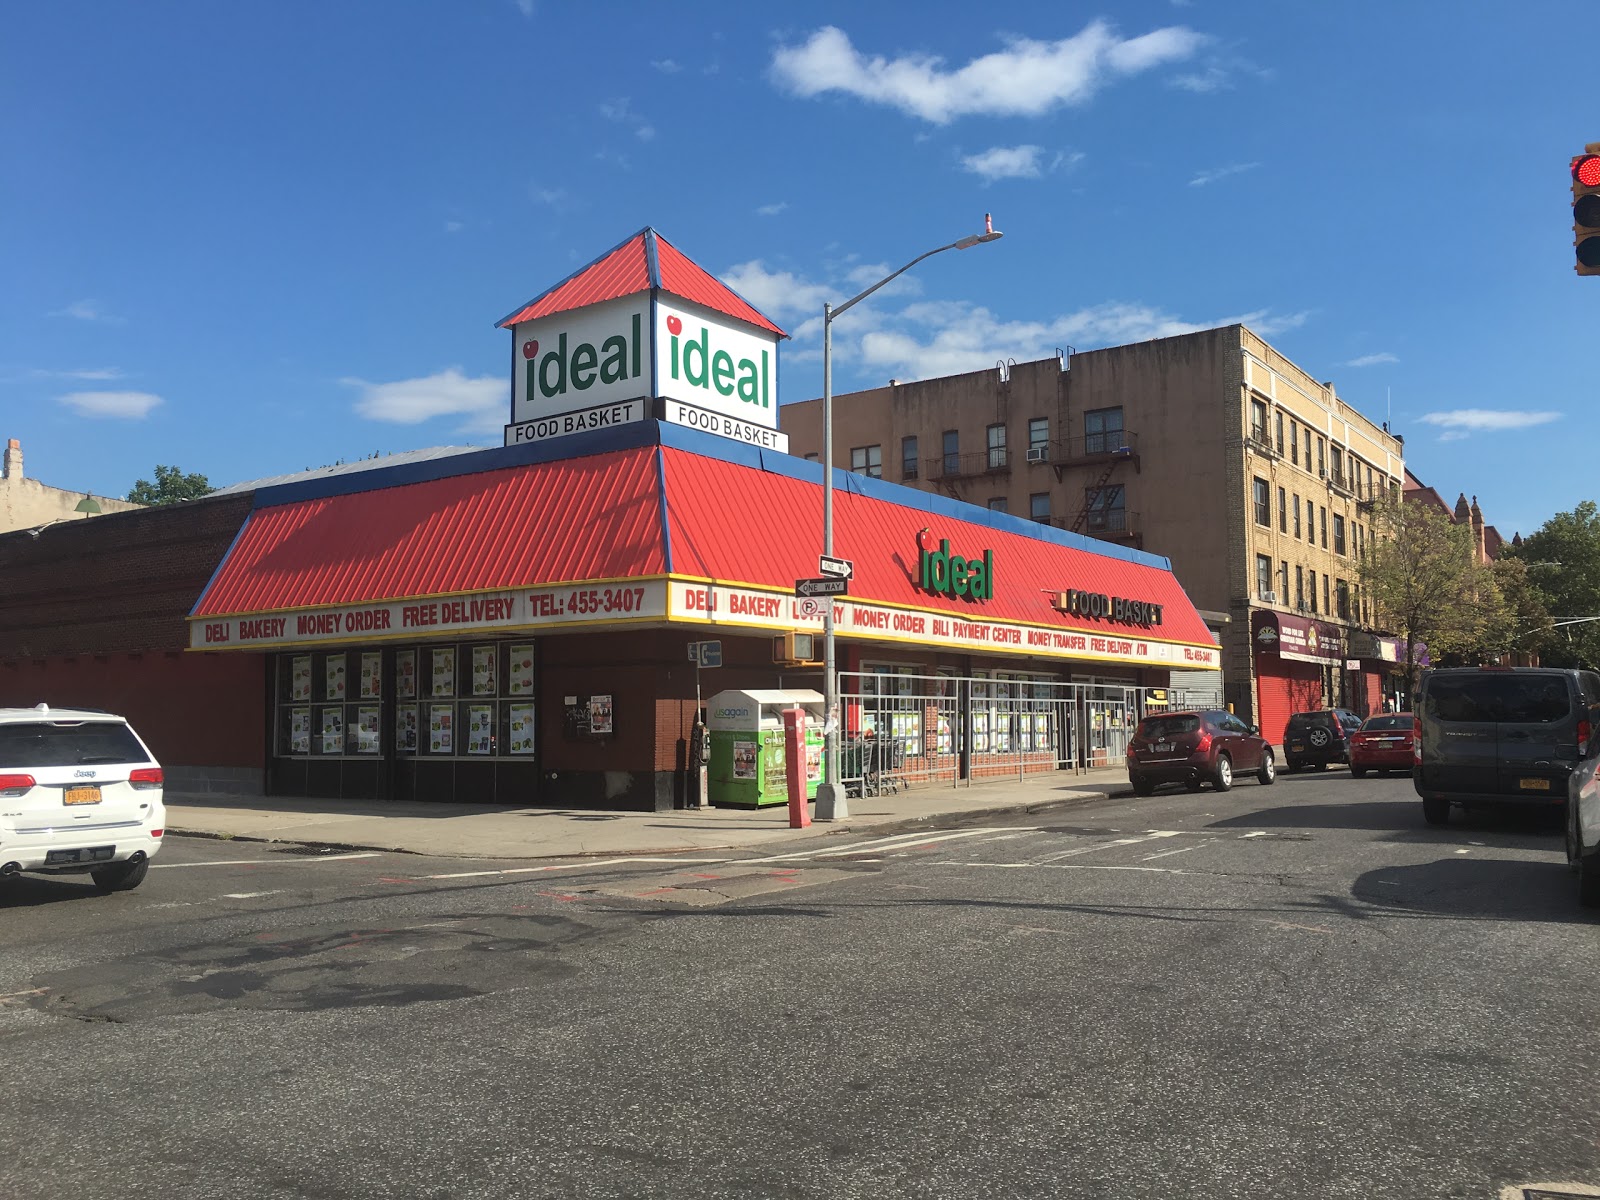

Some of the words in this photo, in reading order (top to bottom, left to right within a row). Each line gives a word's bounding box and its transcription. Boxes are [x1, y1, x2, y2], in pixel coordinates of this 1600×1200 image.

[523, 313, 641, 401] ideal
[667, 314, 769, 408] ideal
[515, 420, 559, 443] FOOD
[564, 404, 633, 431] BASKET
[679, 406, 719, 431] FOOD
[724, 420, 778, 448] BASKET
[824, 561, 834, 571] ONE
[838, 565, 848, 573] WAY
[918, 528, 993, 600] ideal
[685, 589, 718, 612] DELI
[729, 593, 782, 618] BAKERY
[803, 584, 818, 592] ONE
[824, 583, 841, 591] WAY
[1069, 589, 1109, 618] FOOD
[1112, 597, 1163, 625] BASKET
[205, 622, 230, 643] DELI
[239, 617, 287, 640] BAKERY
[297, 613, 343, 636] MONEY
[345, 608, 391, 633] ORDER
[402, 603, 438, 628] FREE
[441, 597, 515, 624] DELIVERY
[529, 593, 564, 617] TEL:
[567, 588, 645, 614] 455-3407
[853, 607, 891, 629] MONEY
[893, 613, 926, 634] ORDER
[932, 619, 949, 637] BILL
[952, 621, 990, 641] PAYMENT
[992, 627, 1022, 645] CENTER
[1027, 630, 1052, 647] MONEY
[1053, 633, 1086, 650] TRANSFER
[1090, 637, 1106, 652] FREE
[1106, 640, 1133, 655] DELIVERY
[73, 769, 97, 779] Jeep
